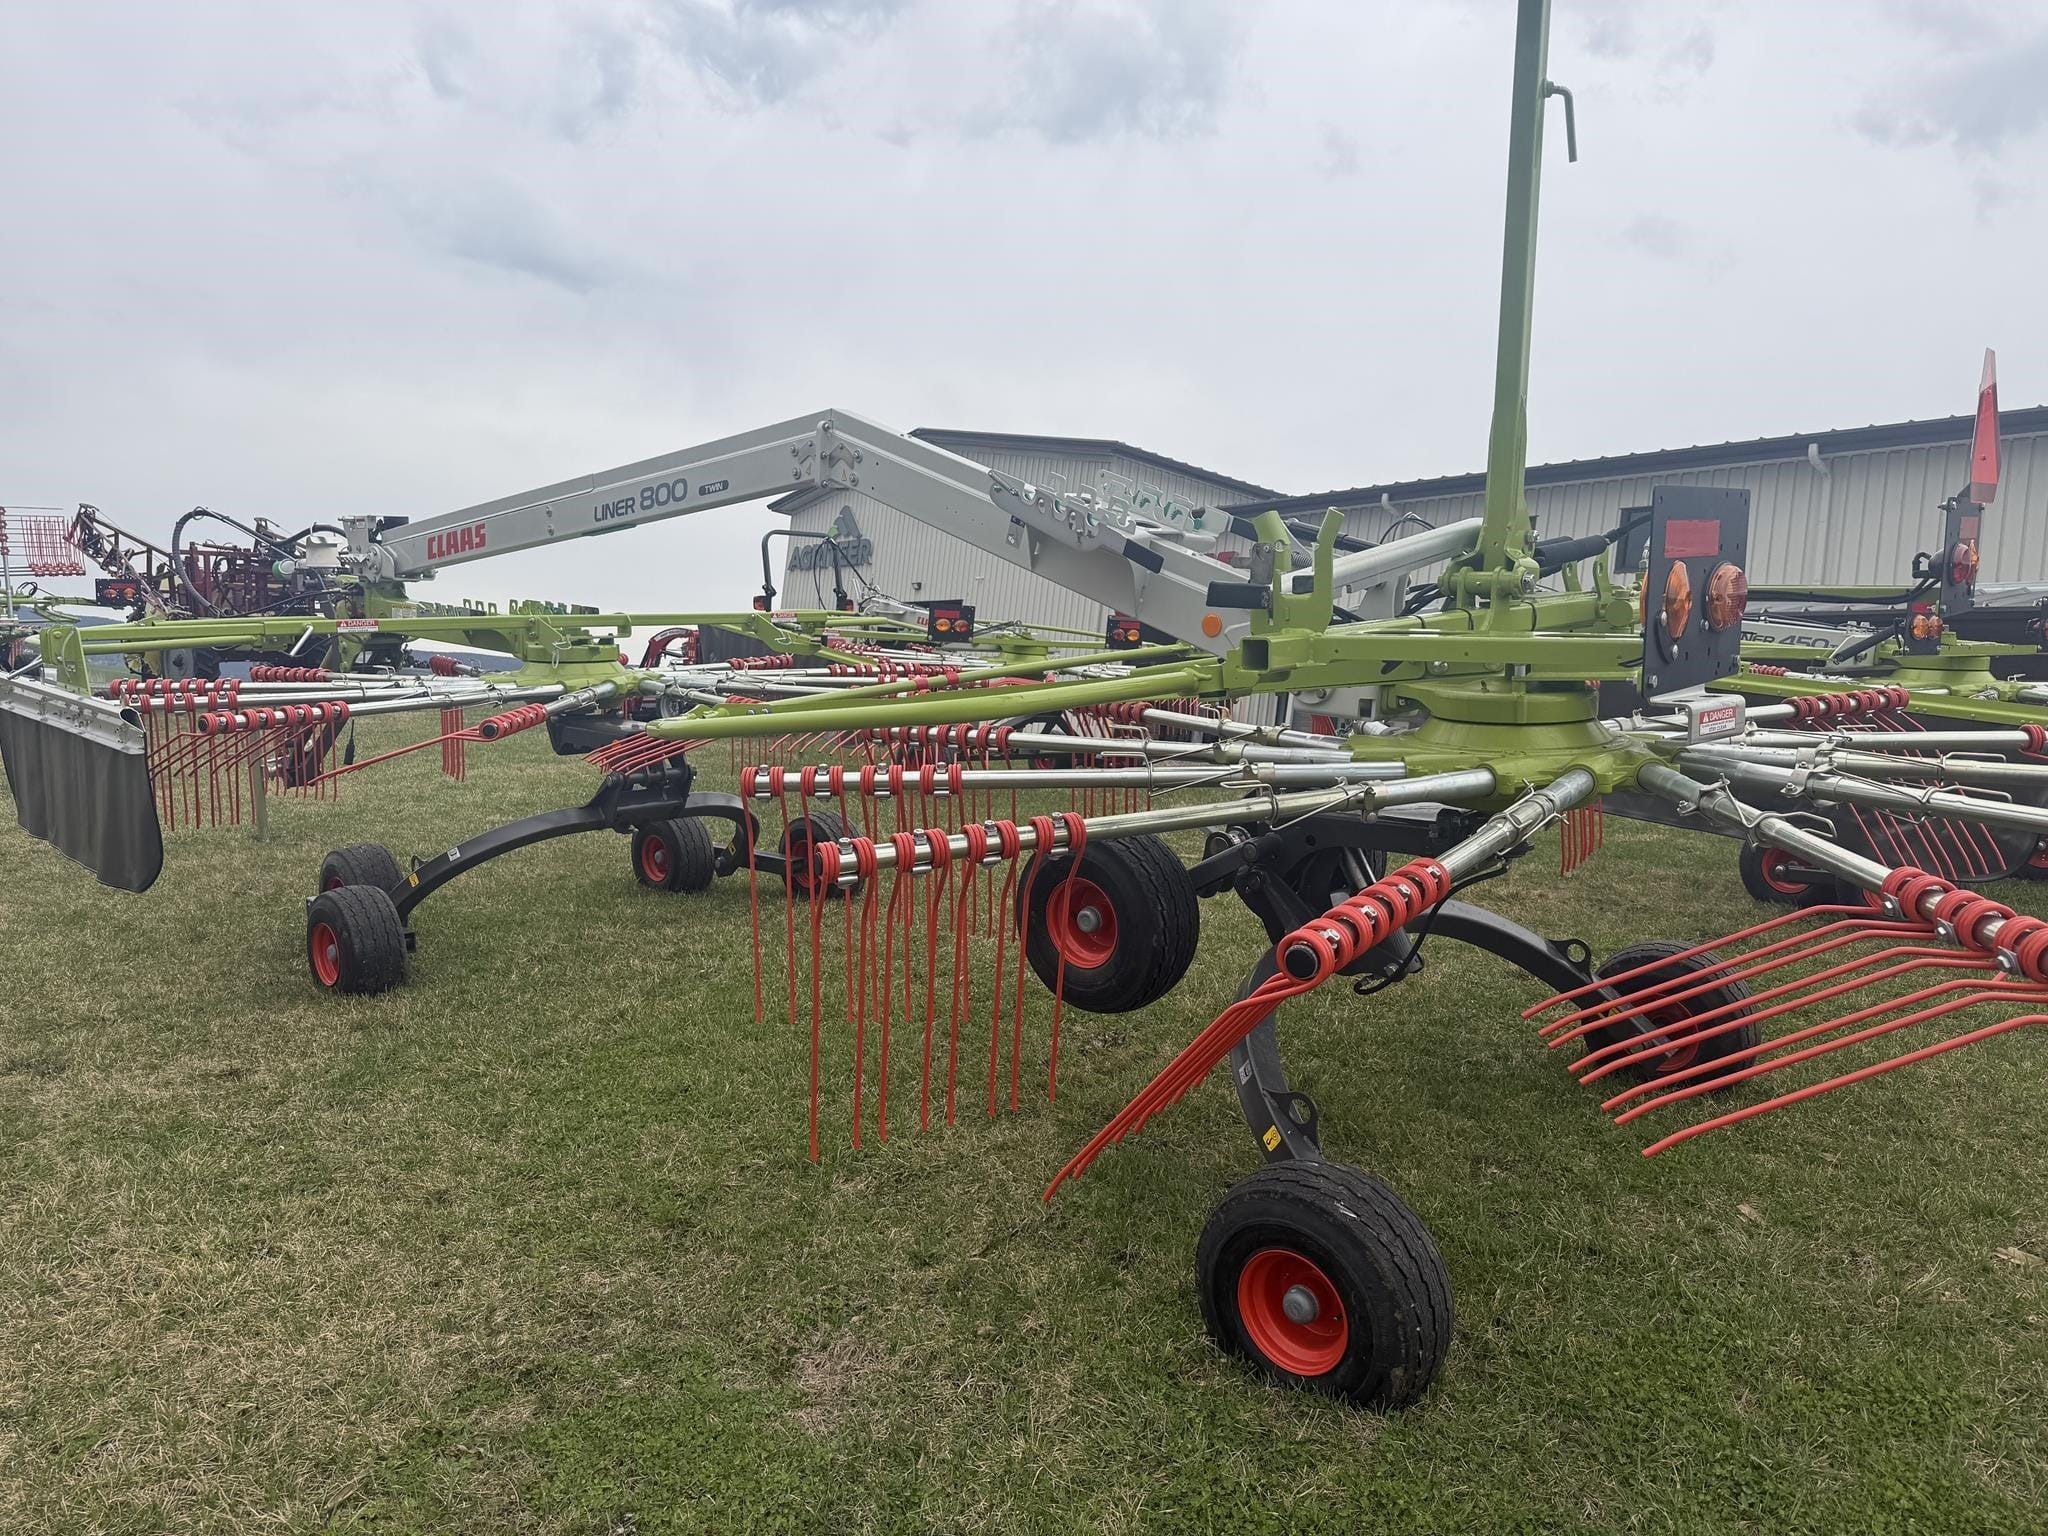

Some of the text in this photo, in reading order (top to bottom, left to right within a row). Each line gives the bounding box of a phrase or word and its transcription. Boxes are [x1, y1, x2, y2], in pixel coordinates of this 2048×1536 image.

[594, 478, 724, 523] LINER 800 TWIN
[427, 522, 487, 561] CLAAS
[348, 619, 376, 627] DANGER
[1779, 635, 1829, 648] 450
[1710, 708, 1734, 721] DANGER
